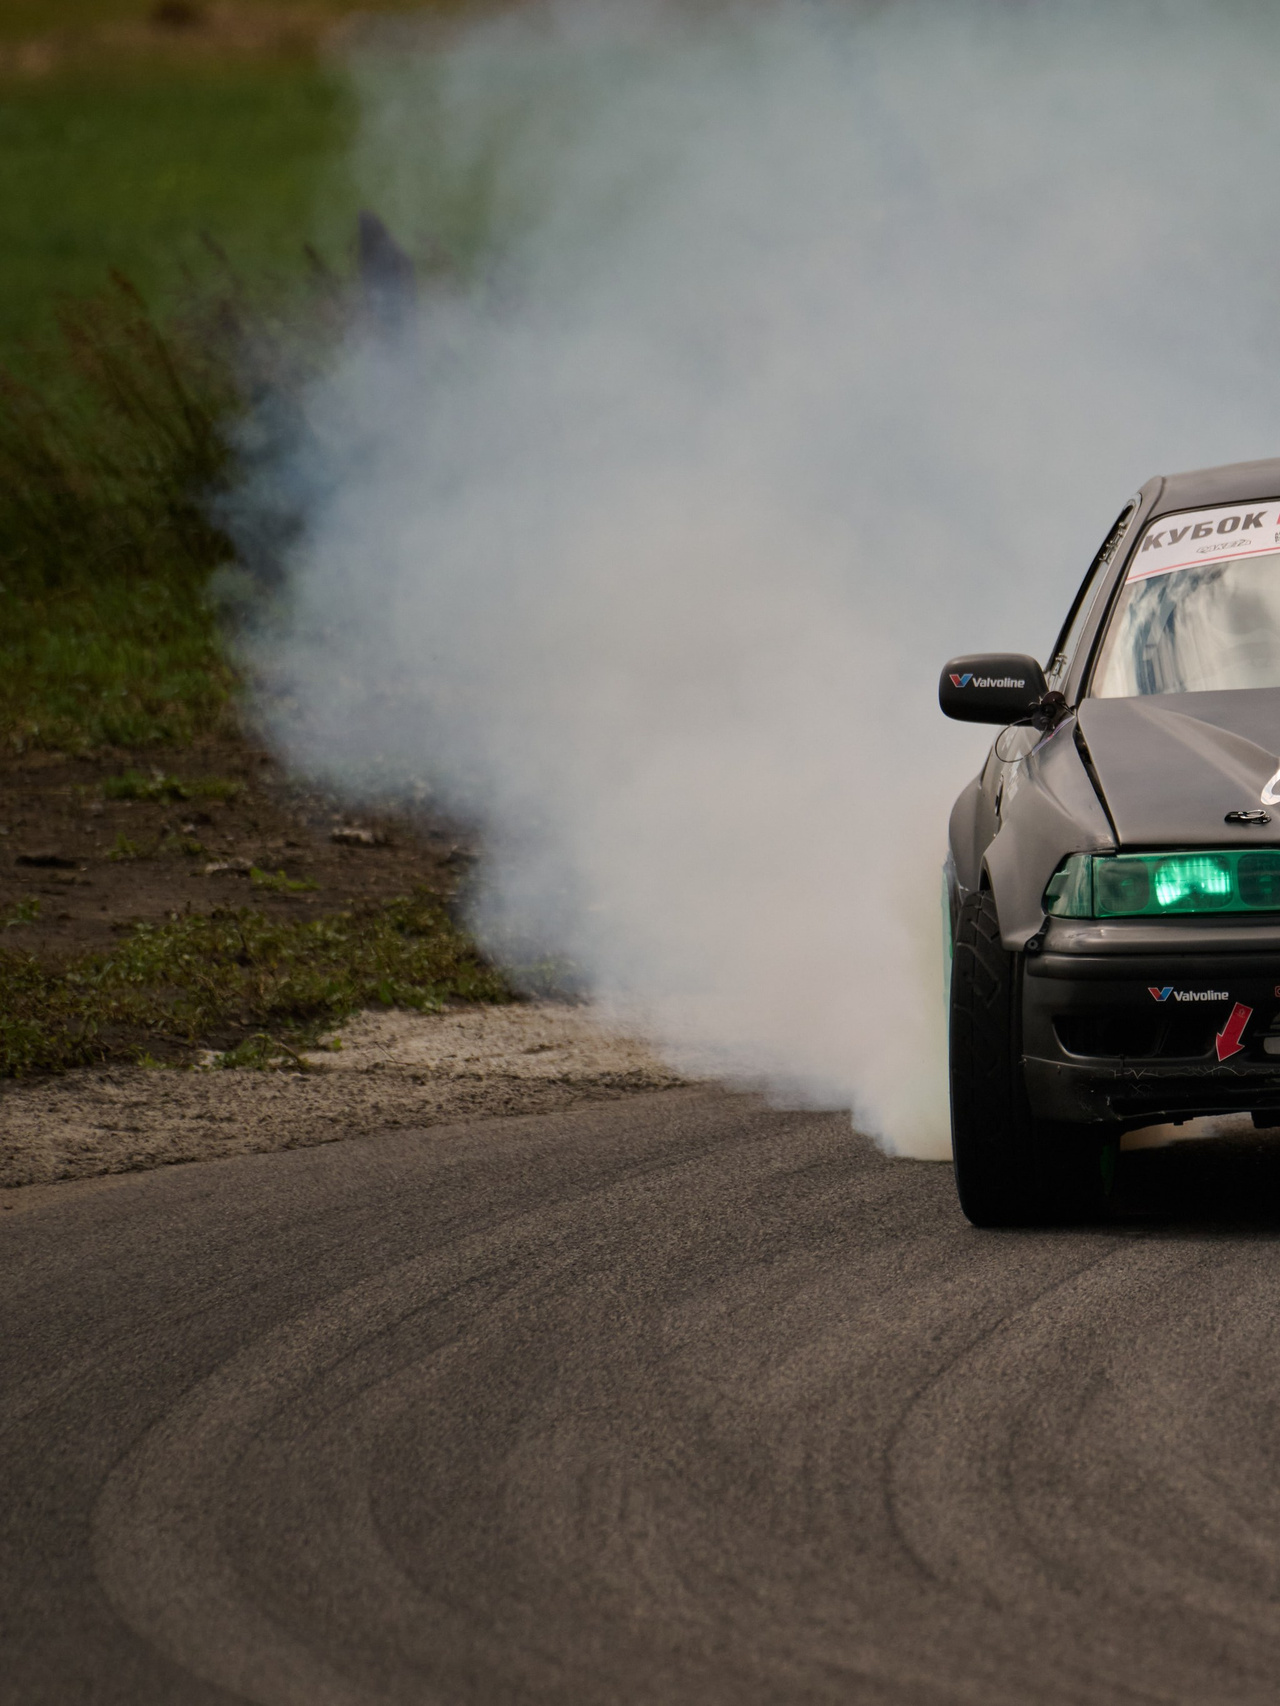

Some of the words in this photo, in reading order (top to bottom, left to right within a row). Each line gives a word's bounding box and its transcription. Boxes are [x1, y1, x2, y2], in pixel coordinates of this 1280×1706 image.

[1141, 510, 1268, 553] КУБОК
[972, 677, 1025, 688] Valvoline
[1173, 989, 1229, 1002] Valvoline
